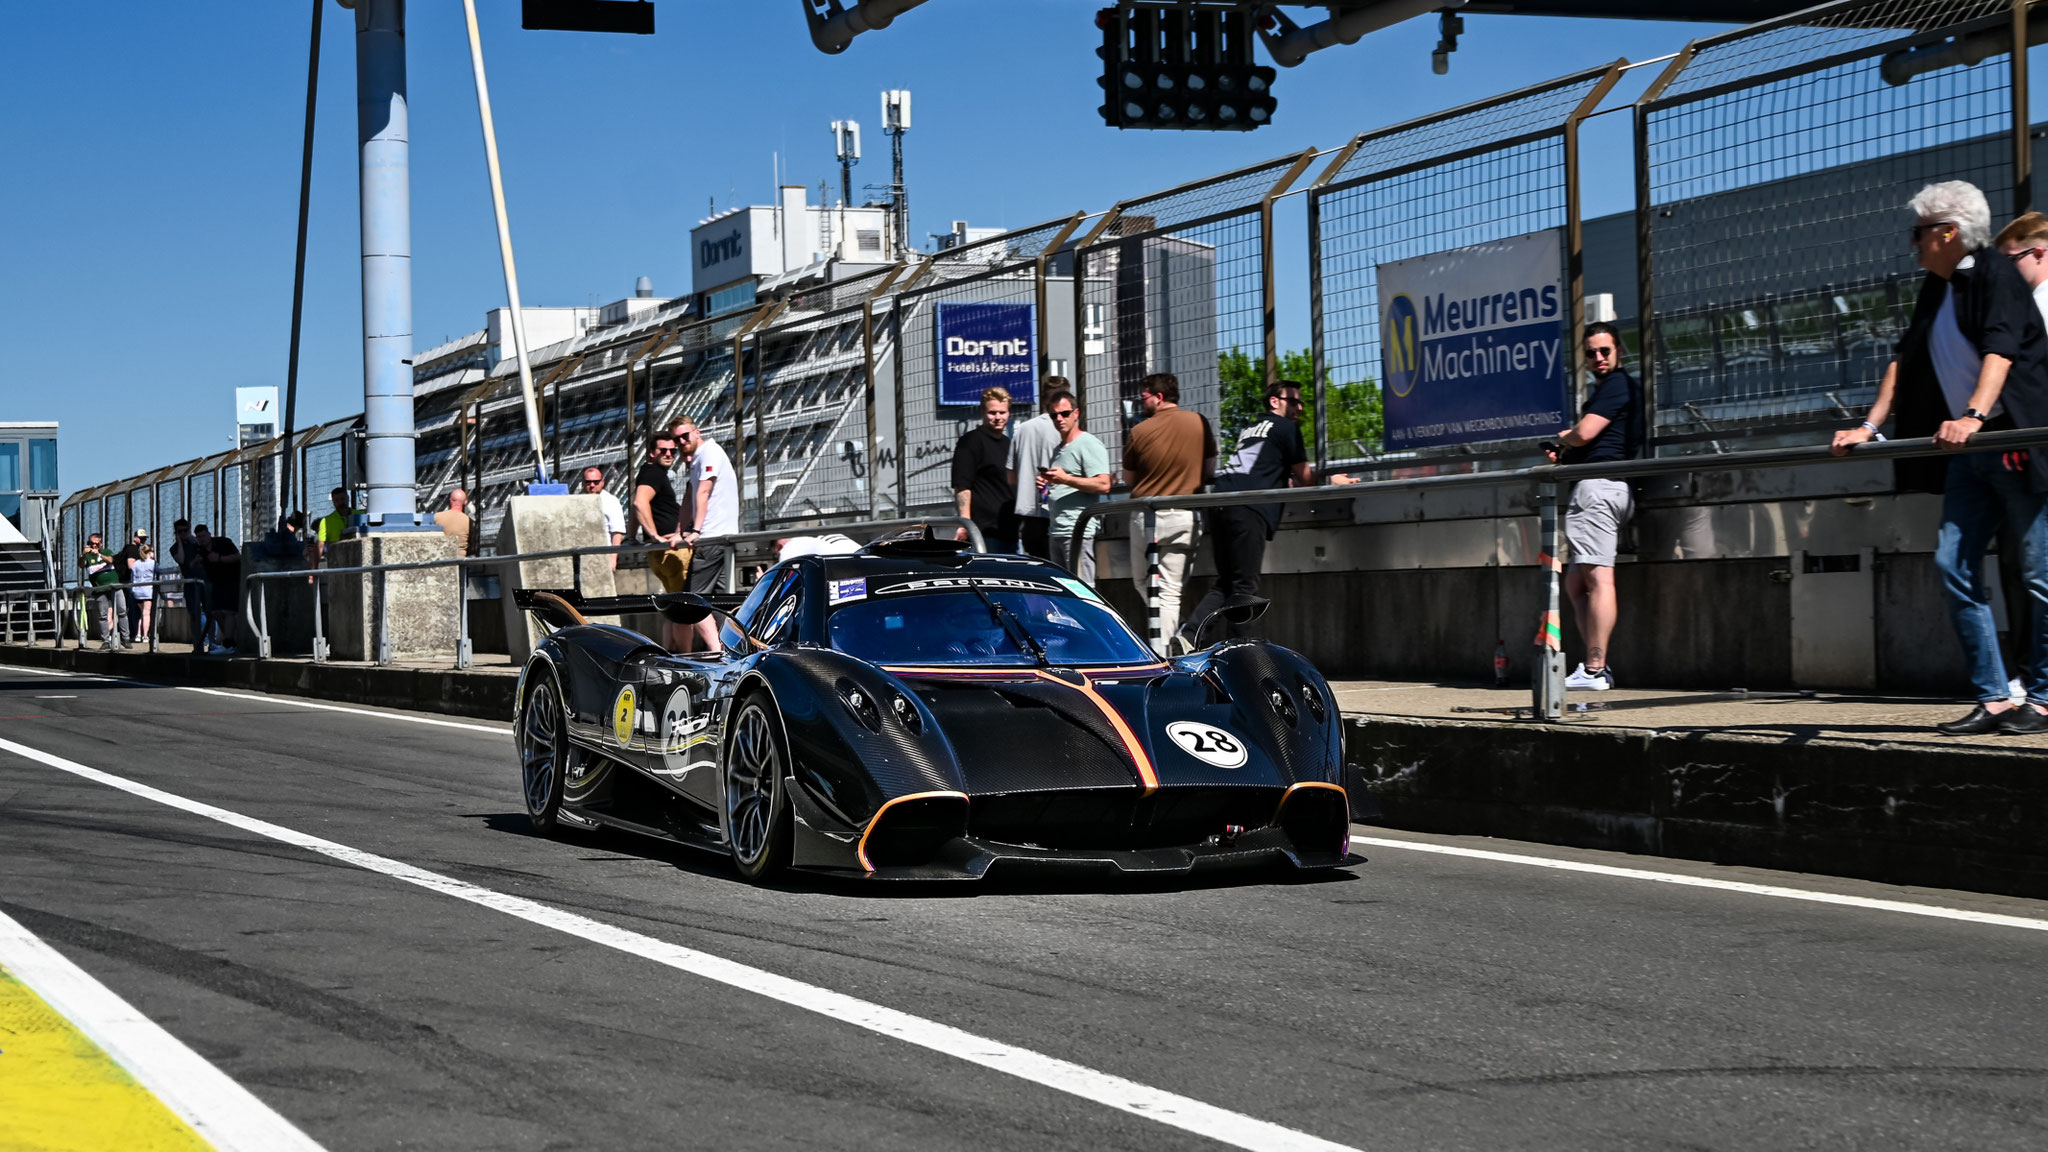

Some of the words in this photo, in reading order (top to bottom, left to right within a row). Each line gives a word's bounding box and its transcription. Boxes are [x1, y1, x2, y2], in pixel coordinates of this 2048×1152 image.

[701, 229, 742, 269] Dorint
[1424, 285, 1558, 336] Meurrens
[946, 337, 1028, 356] Dorint
[947, 362, 980, 373] Hotels
[981, 362, 990, 373] &
[991, 362, 1030, 373] Resorts
[1424, 335, 1560, 382] Machinery
[621, 708, 628, 722] 2
[1178, 731, 1239, 753] 28
